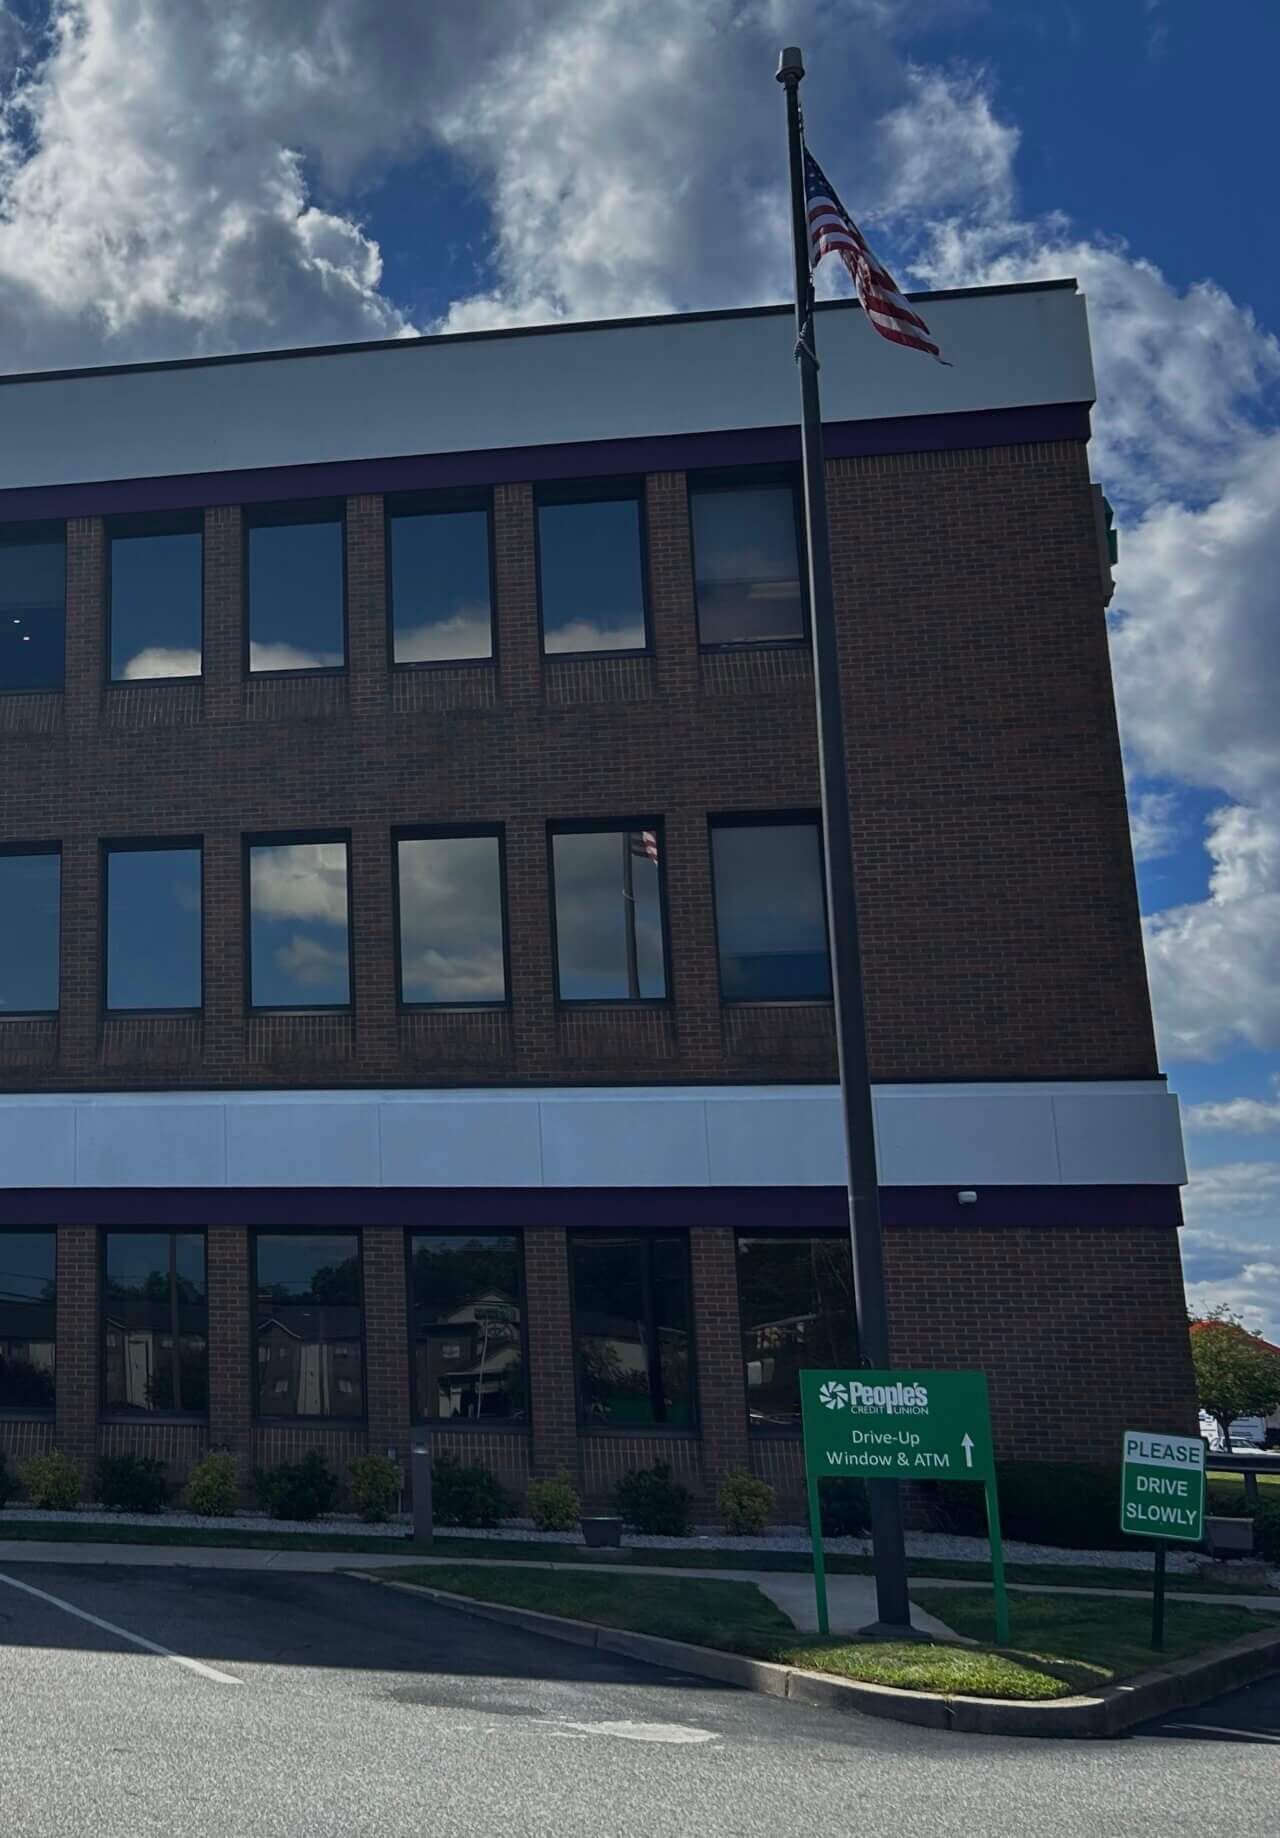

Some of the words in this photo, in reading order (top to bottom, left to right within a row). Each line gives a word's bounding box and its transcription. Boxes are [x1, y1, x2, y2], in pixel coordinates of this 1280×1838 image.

[849, 1381, 928, 1414] People's
[850, 1406, 885, 1414] CREDIT
[893, 1406, 929, 1415] UNION
[852, 1430, 920, 1447] Drive-Up
[826, 1451, 892, 1466] Window
[897, 1452, 910, 1466] &
[914, 1453, 950, 1467] ATM
[1127, 1439, 1201, 1464] PLEASE
[1136, 1475, 1189, 1497] DRIVE
[1126, 1502, 1197, 1526] SLOWLY
